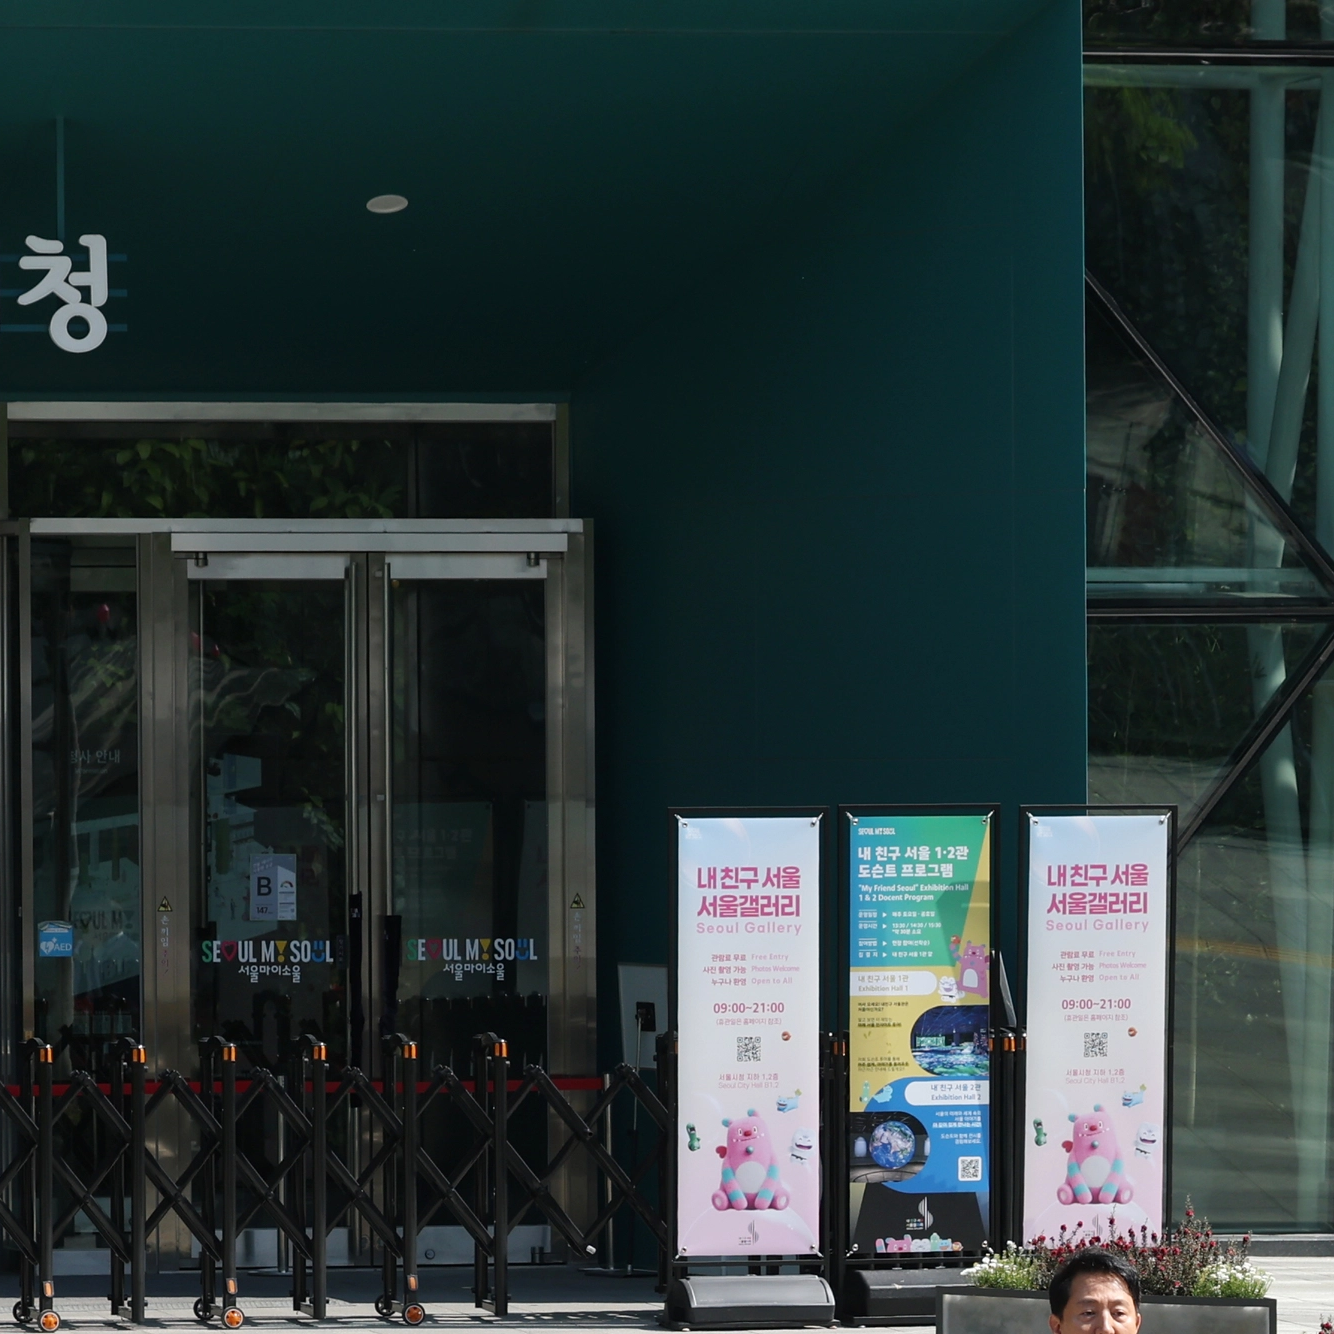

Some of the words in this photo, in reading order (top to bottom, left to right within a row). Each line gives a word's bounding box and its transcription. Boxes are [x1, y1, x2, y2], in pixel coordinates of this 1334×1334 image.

[858, 846, 871, 861] 내
[875, 846, 901, 861] 친구
[904, 845, 930, 861] 서울
[901, 863, 953, 878] 프로그램
[1047, 864, 1067, 887] 내
[1070, 863, 1108, 887] 친구
[1110, 863, 1149, 887] 서울
[697, 866, 717, 889] 내
[720, 866, 759, 889] 친구
[762, 866, 801, 889] 서울
[257, 876, 272, 896] B
[874, 884, 895, 892] Friend
[920, 883, 954, 892] Exhibition
[955, 883, 969, 891] Hall
[904, 894, 934, 902] Program
[697, 894, 801, 918] 서울갤러리
[1046, 892, 1148, 915] 서울갤러리
[256, 906, 268, 914] 147
[696, 922, 740, 934] Seoul
[744, 922, 802, 936] Gallery
[1046, 919, 1088, 931] Seoul
[1093, 919, 1149, 933] Gallery
[732, 953, 747, 962] 무료
[751, 953, 767, 961] Free
[769, 953, 789, 962] Entry
[1081, 951, 1095, 959] 무료
[1117, 950, 1136, 958] Entry
[702, 965, 717, 974] 사진
[732, 965, 747, 974] 가능
[1051, 963, 1065, 971] 사진
[1081, 962, 1095, 971] 가능
[238, 965, 301, 983] 서울마이소울
[443, 962, 505, 982] 서울마이소울
[711, 978, 732, 986] 누구나
[733, 977, 747, 986] 환영
[751, 977, 770, 985] Open
[782, 976, 793, 984] All
[858, 975, 865, 983] 내
[867, 975, 880, 983] 친구
[882, 975, 896, 983] 서울
[1060, 975, 1080, 983] 누구나
[1081, 974, 1094, 983] 환영
[1098, 974, 1118, 982] Open
[1130, 973, 1140, 981] All
[713, 1002, 785, 1014] 09:00~21:00
[1061, 998, 1132, 1010] 09:00~21:00
[743, 1018, 766, 1026] 홈페이지
[1090, 1014, 1113, 1022] 홈페이지
[718, 1073, 744, 1081] 서울시청
[1066, 1068, 1091, 1077] 서울시청
[718, 1081, 736, 1089] Seoul
[737, 1081, 750, 1090] City
[751, 1081, 763, 1089] Hall
[1083, 1077, 1096, 1085] City
